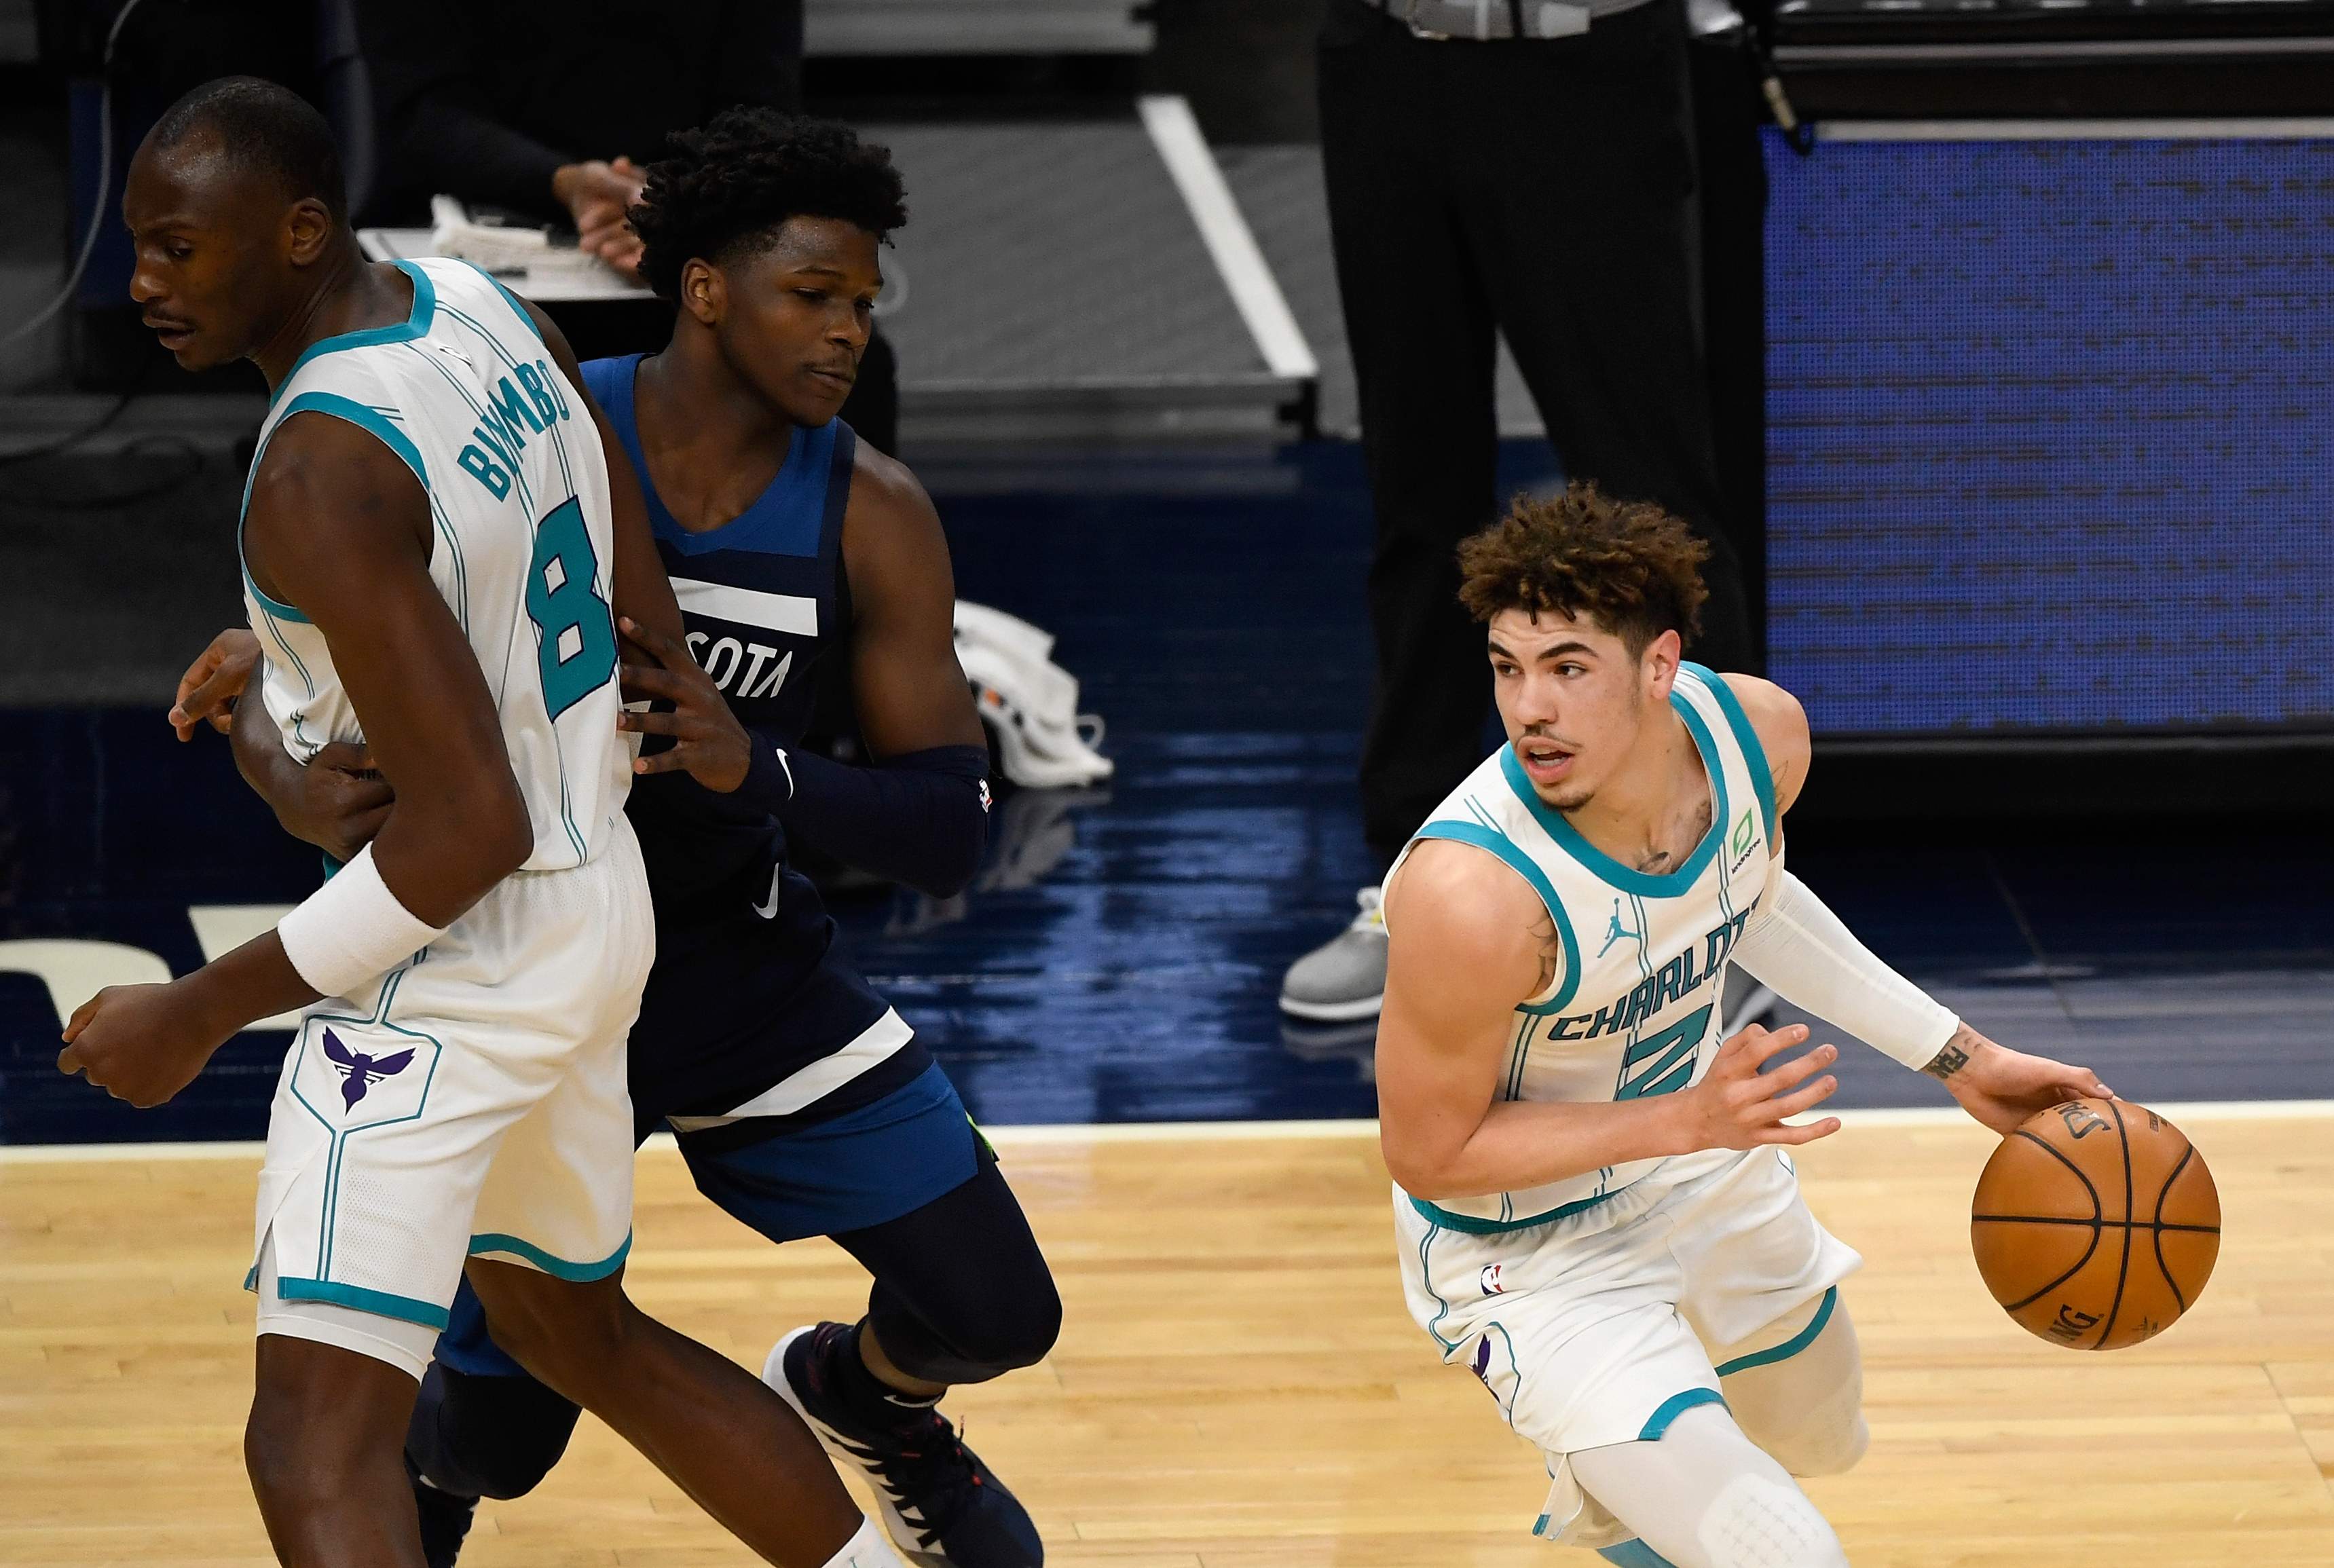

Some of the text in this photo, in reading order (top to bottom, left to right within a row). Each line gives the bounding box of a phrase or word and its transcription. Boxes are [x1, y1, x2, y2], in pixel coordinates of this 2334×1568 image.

[525, 494, 618, 724] 8
[1547, 887, 1765, 1041] CHARLOT
[1613, 1002, 1714, 1101] 2
